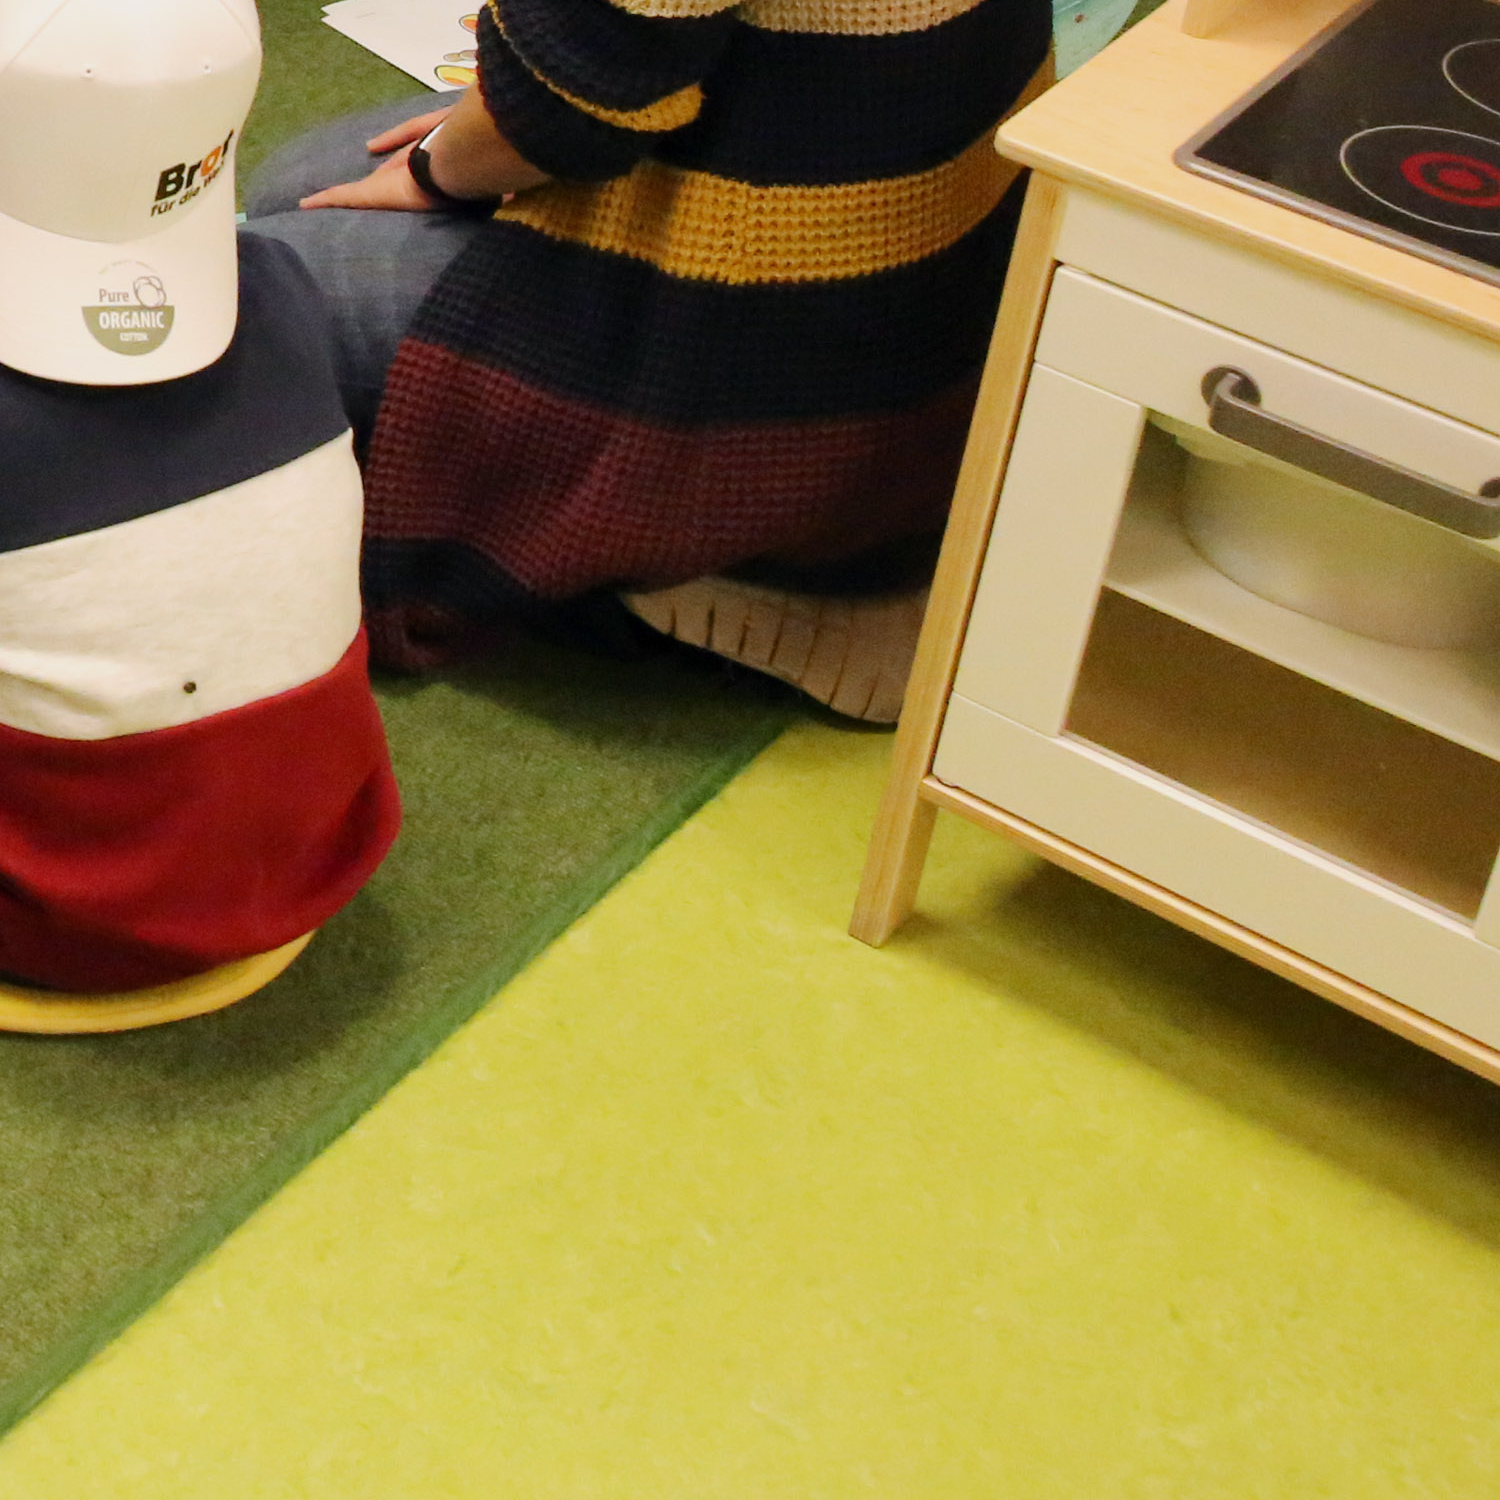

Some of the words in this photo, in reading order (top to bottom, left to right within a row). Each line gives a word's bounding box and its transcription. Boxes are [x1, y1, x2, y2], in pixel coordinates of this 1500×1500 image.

[155, 128, 235, 202] Brot
[99, 288, 130, 303] Pure
[99, 311, 165, 329] ORGANIC
